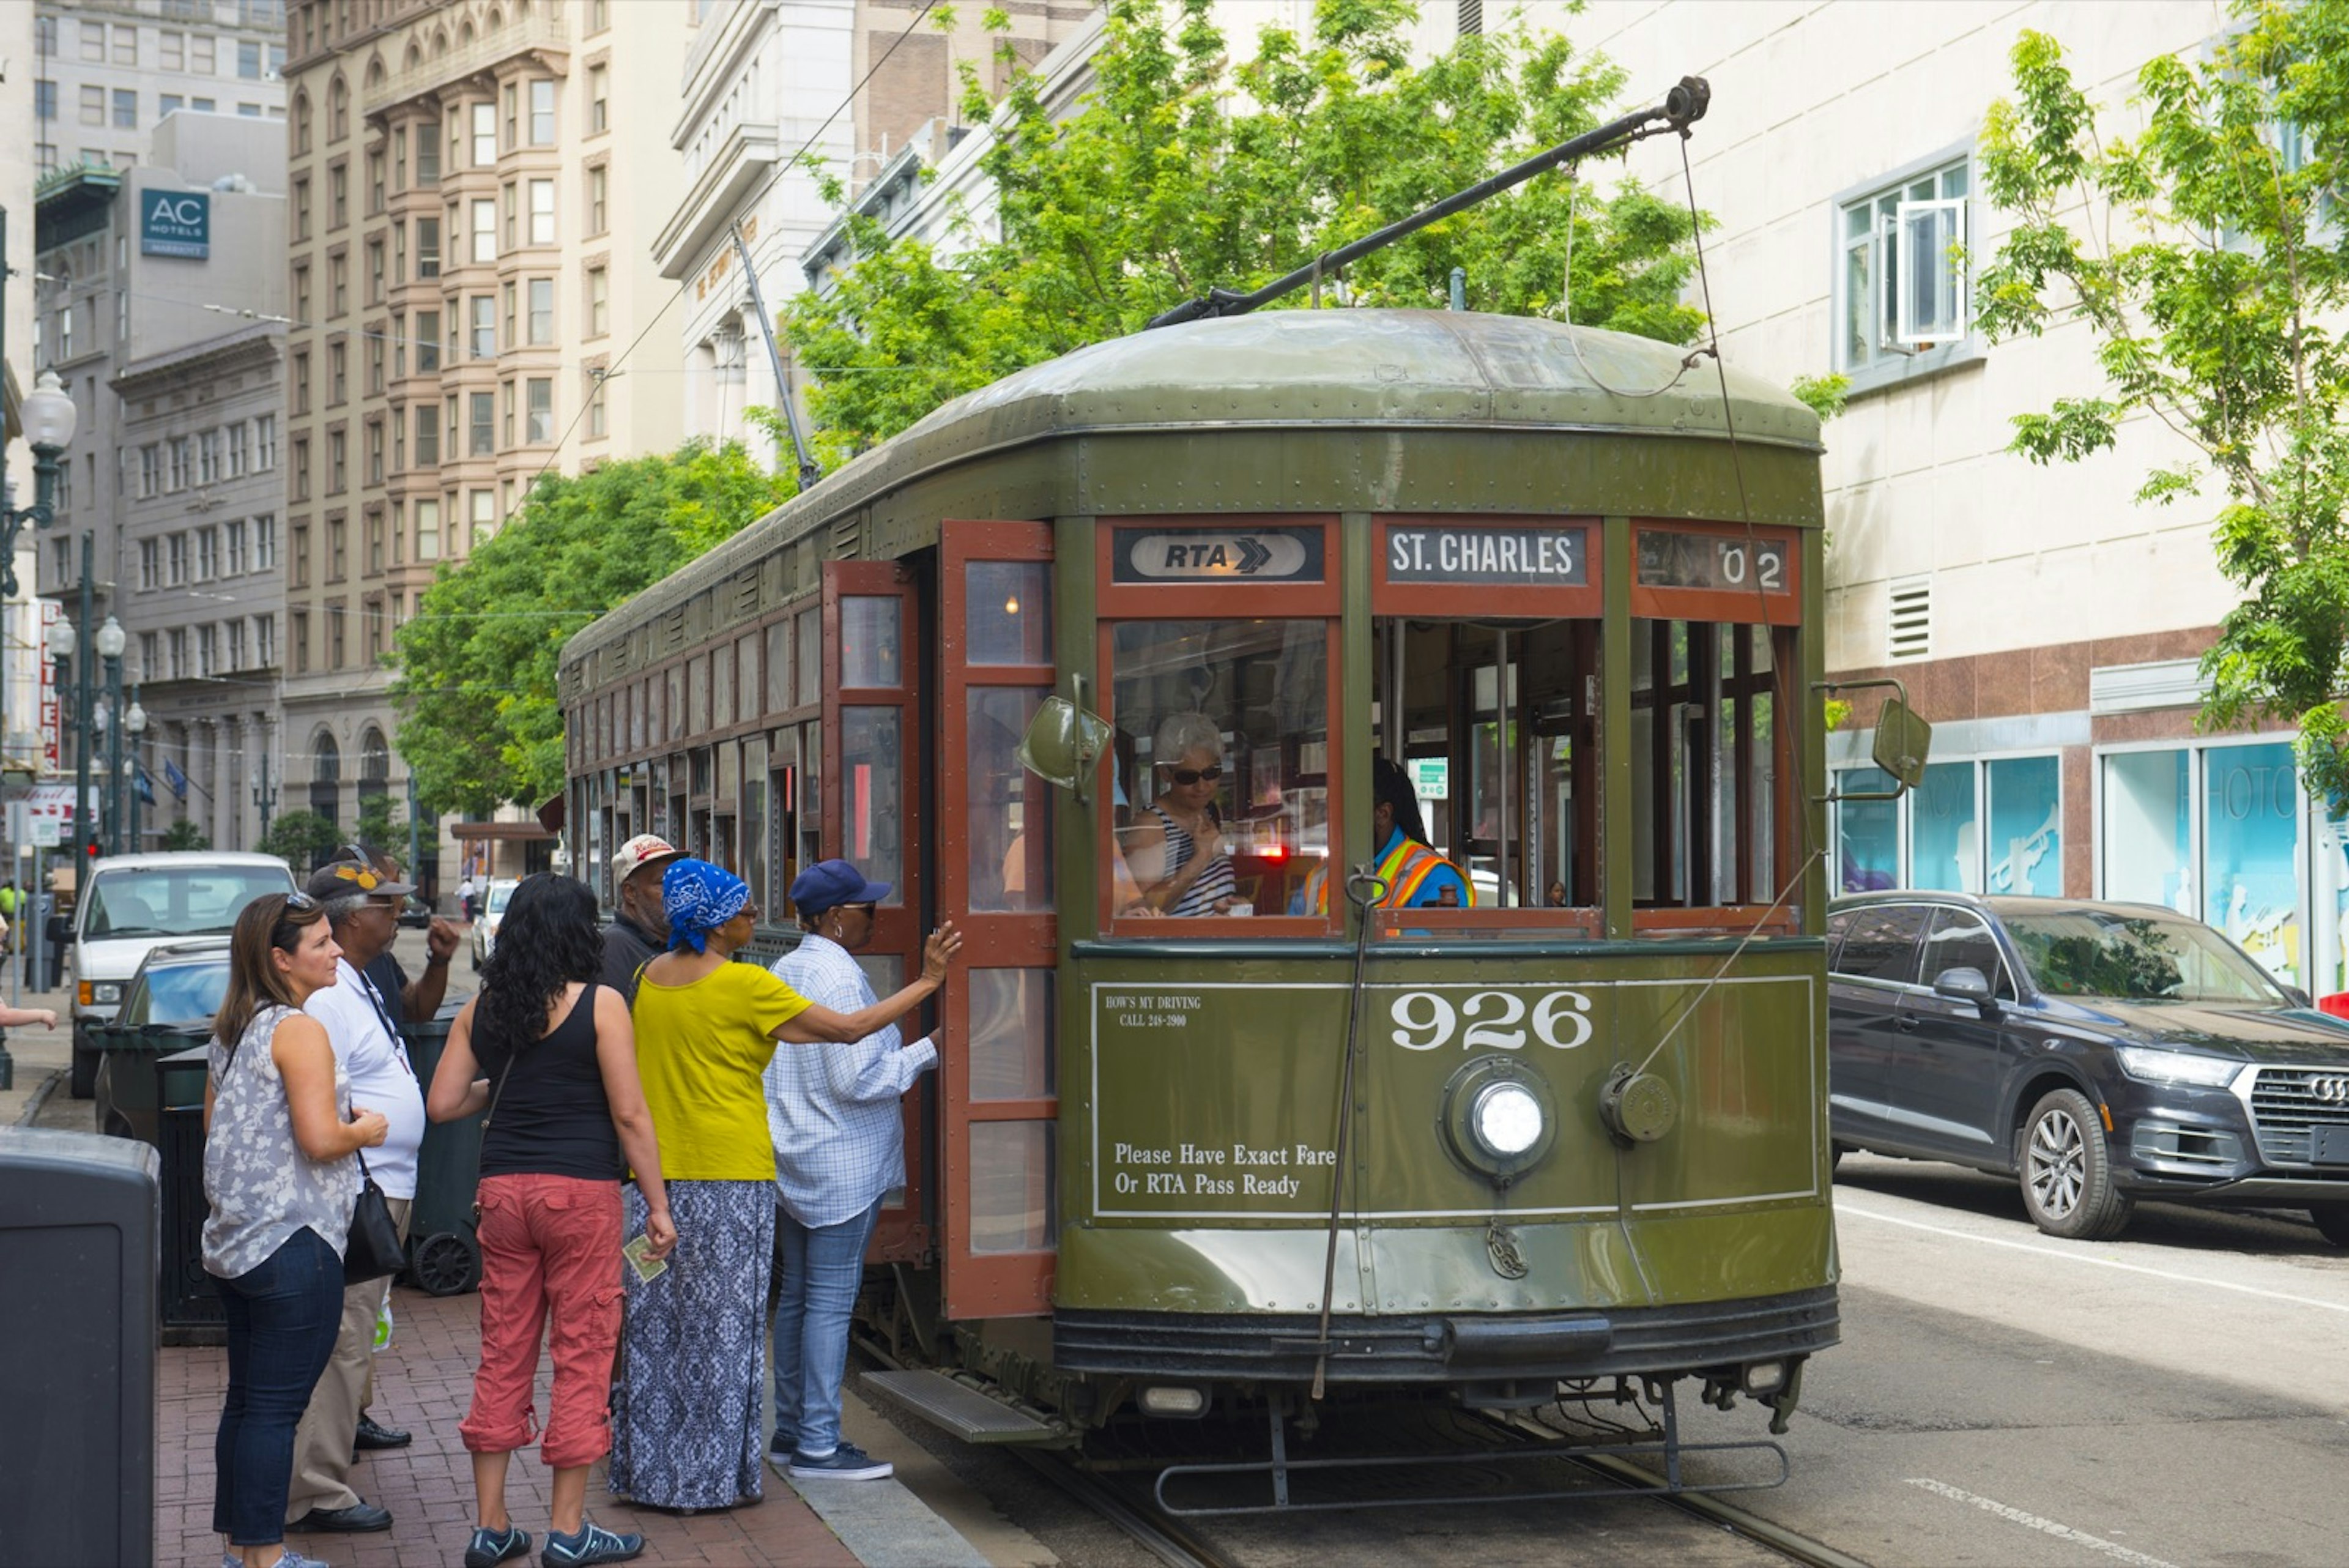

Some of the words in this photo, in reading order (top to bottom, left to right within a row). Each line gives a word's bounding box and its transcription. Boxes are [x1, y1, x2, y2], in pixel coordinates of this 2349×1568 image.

[151, 197, 202, 225] AC
[150, 225, 202, 237] HOTELS
[1165, 544, 1228, 568] RTA
[1392, 533, 1432, 571] ST.
[1439, 534, 1572, 574] CHARLES
[1105, 996, 1136, 1009] HOW'S
[1139, 996, 1154, 1009] MY
[1157, 996, 1201, 1010] DRIVING
[1119, 1014, 1146, 1027] CALL
[1391, 990, 1592, 1051] 926
[1115, 1143, 1172, 1164] Please
[1179, 1144, 1225, 1164] Have
[1233, 1144, 1288, 1165] Exact
[1296, 1145, 1337, 1165] Fare
[1115, 1172, 1138, 1194] Or
[1146, 1173, 1187, 1194] RTA
[1195, 1174, 1235, 1194] Pass
[1243, 1175, 1301, 1198] Ready
